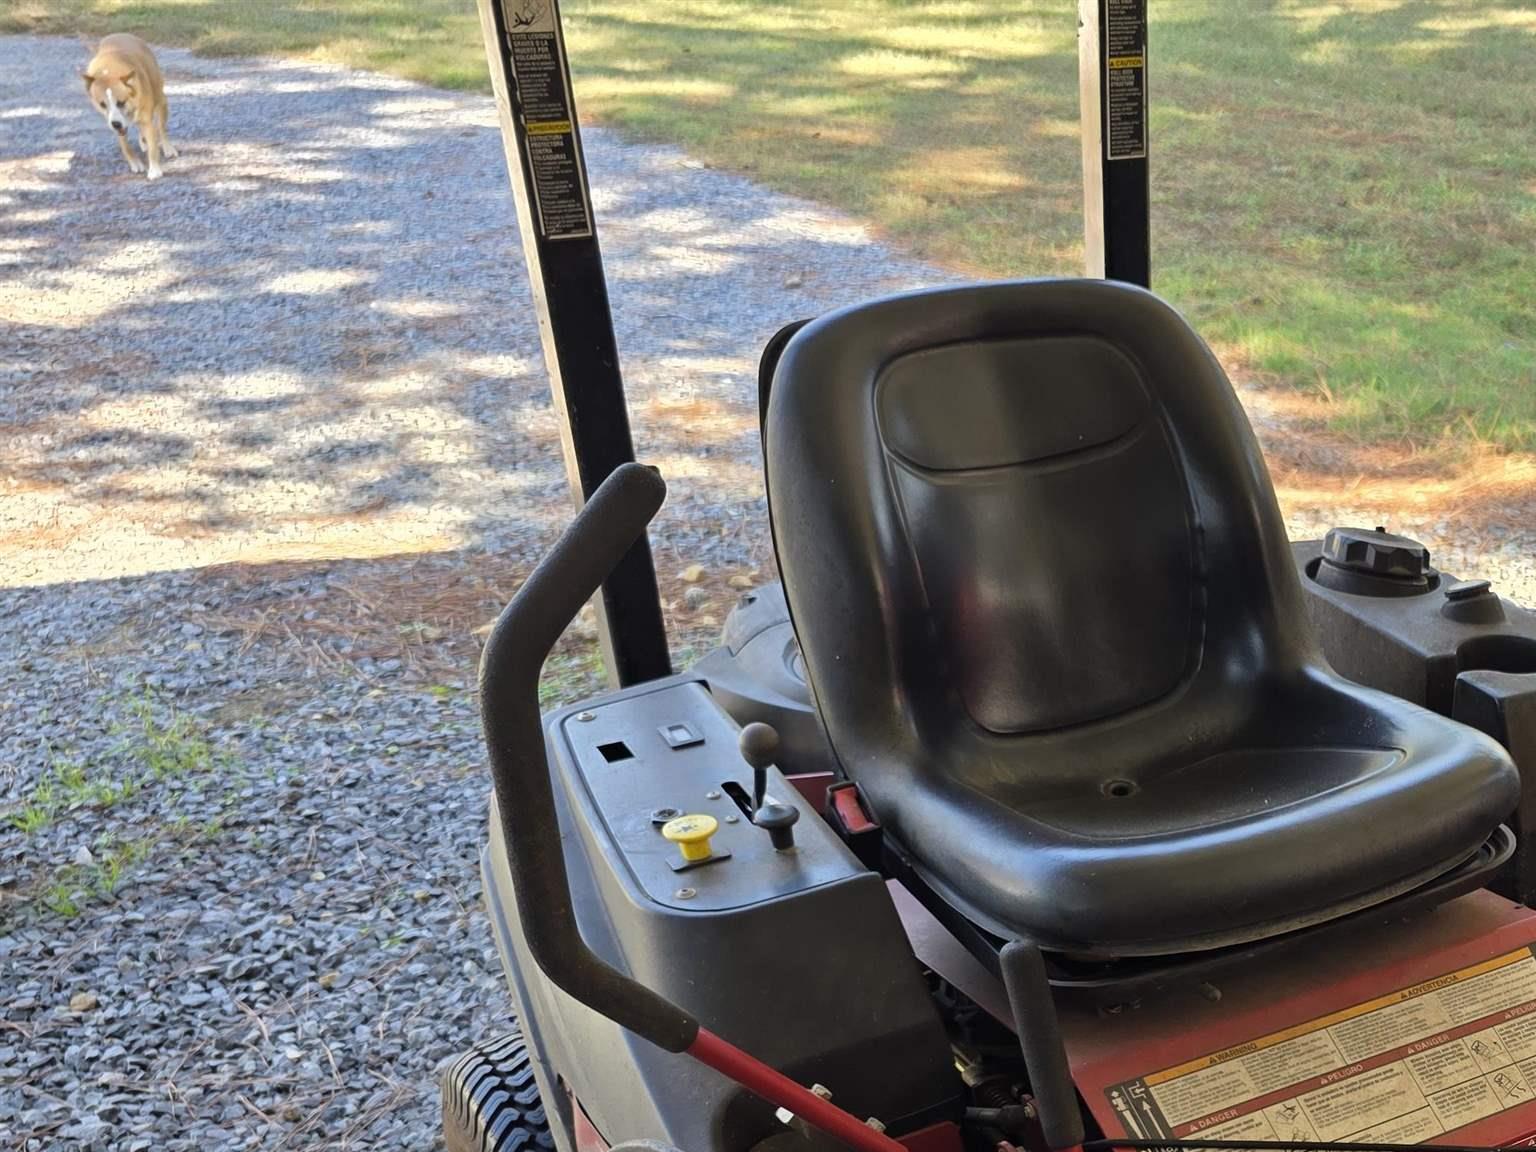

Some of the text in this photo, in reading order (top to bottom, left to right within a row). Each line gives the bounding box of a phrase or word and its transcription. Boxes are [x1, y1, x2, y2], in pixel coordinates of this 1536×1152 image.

[1408, 975, 1458, 998] ADVERTENCIA
[1415, 1034, 1449, 1051] DANGER
[1215, 1043, 1258, 1063] WARNING
[1327, 1064, 1364, 1083] PELIGRO
[1200, 1109, 1239, 1127] DANGER
